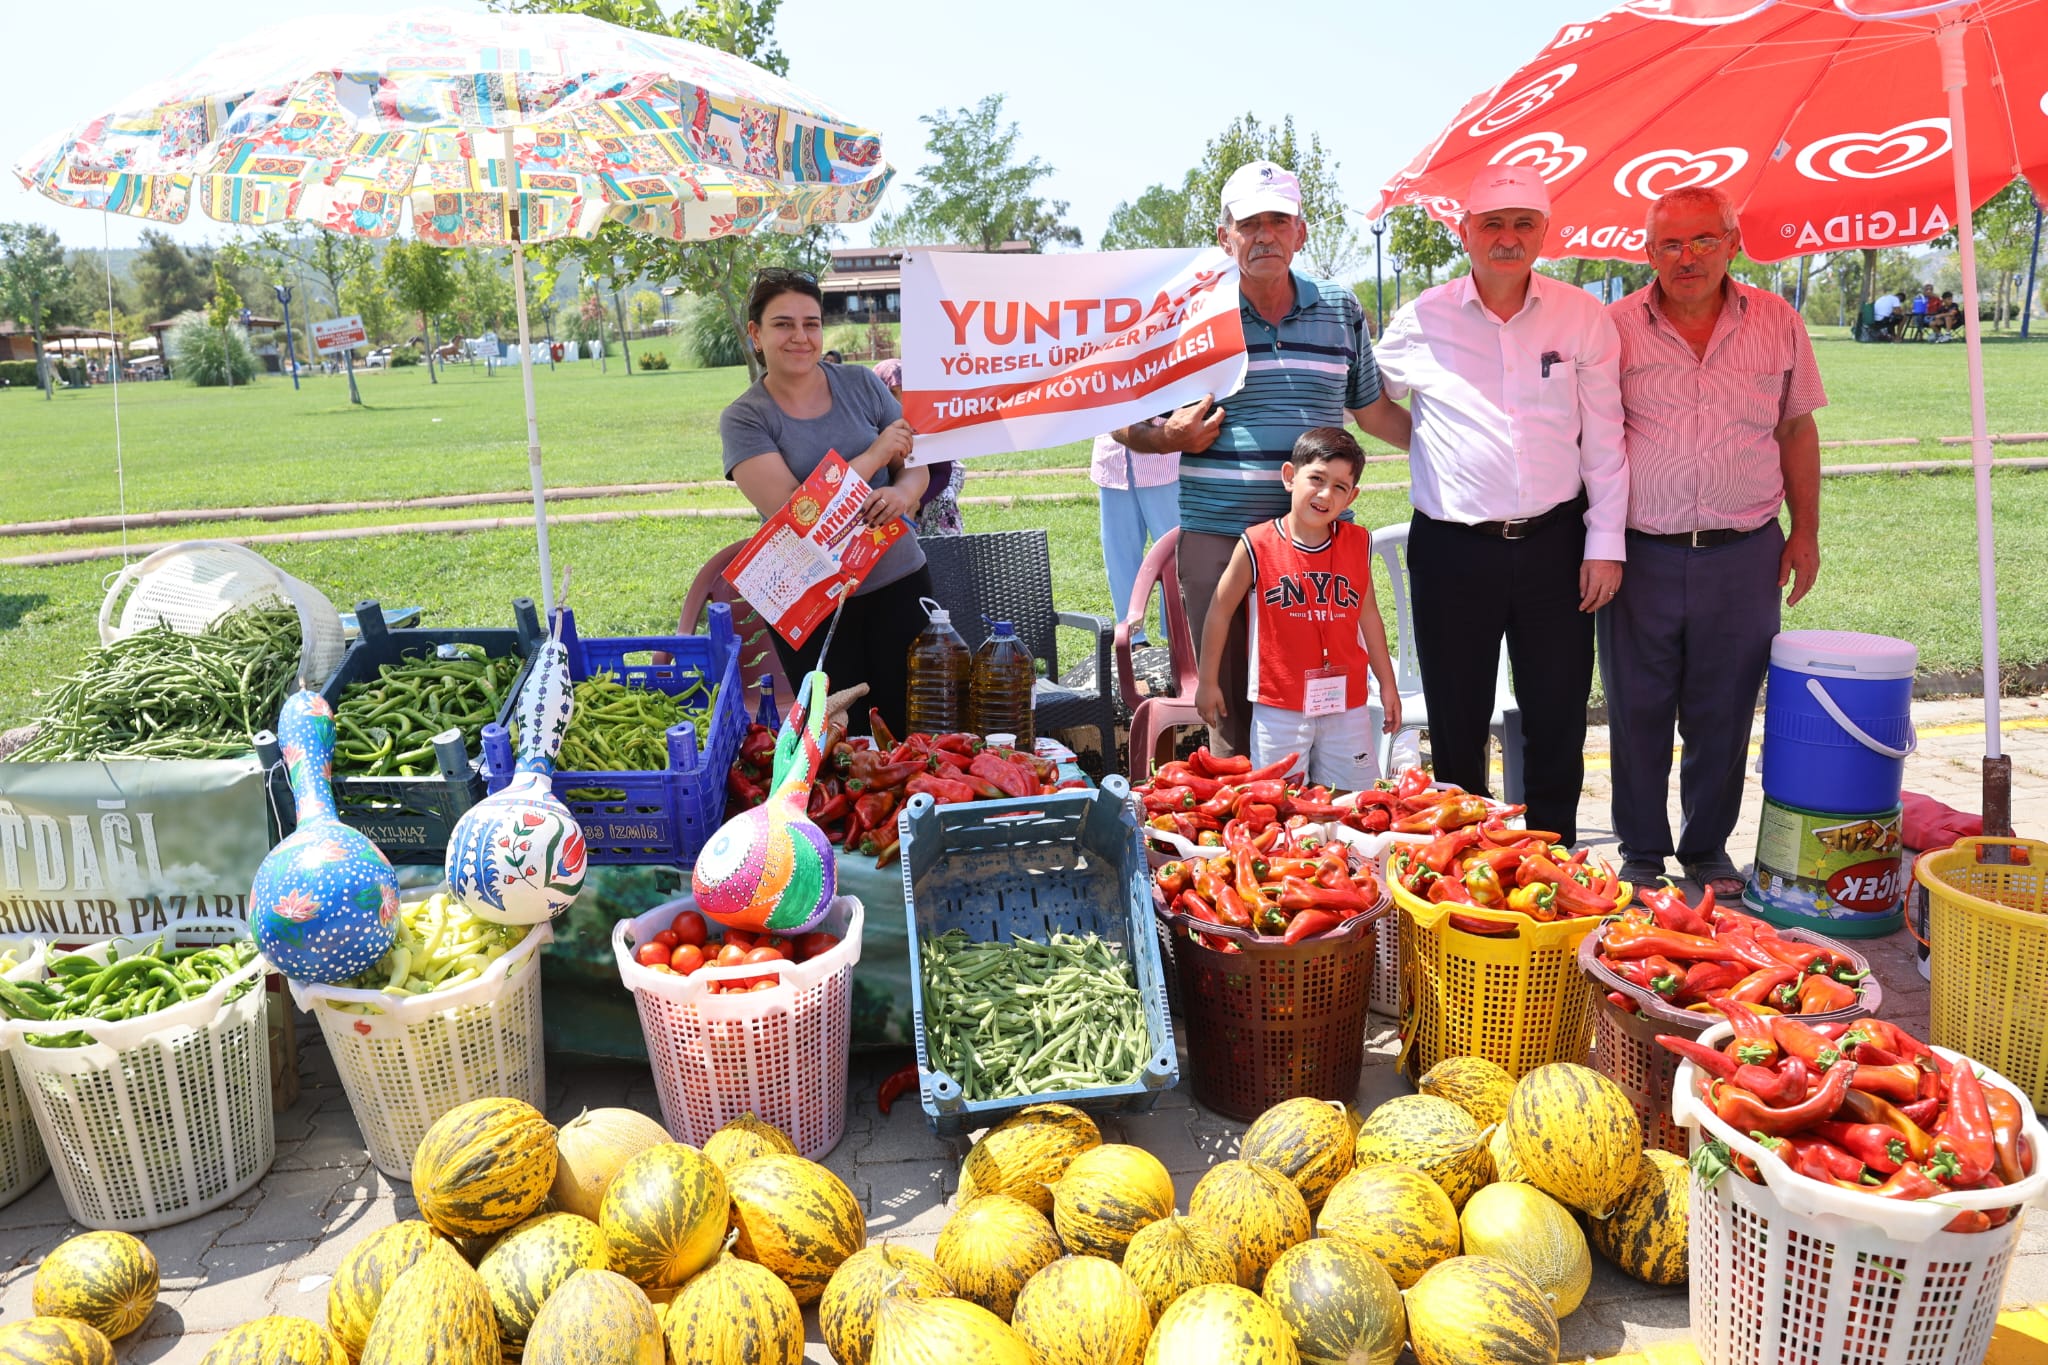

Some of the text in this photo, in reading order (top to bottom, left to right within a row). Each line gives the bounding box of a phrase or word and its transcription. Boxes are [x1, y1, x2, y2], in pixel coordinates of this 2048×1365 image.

[933, 325, 1215, 418] TÜRKMEN KÖYÜ MAHALLESİ
[940, 352, 1043, 375] YÖRESEL
[812, 479, 870, 547] MATEMATİK
[888, 523, 900, 536] 5
[1279, 571, 1350, 609] NYC
[378, 826, 428, 838] YILMAZ
